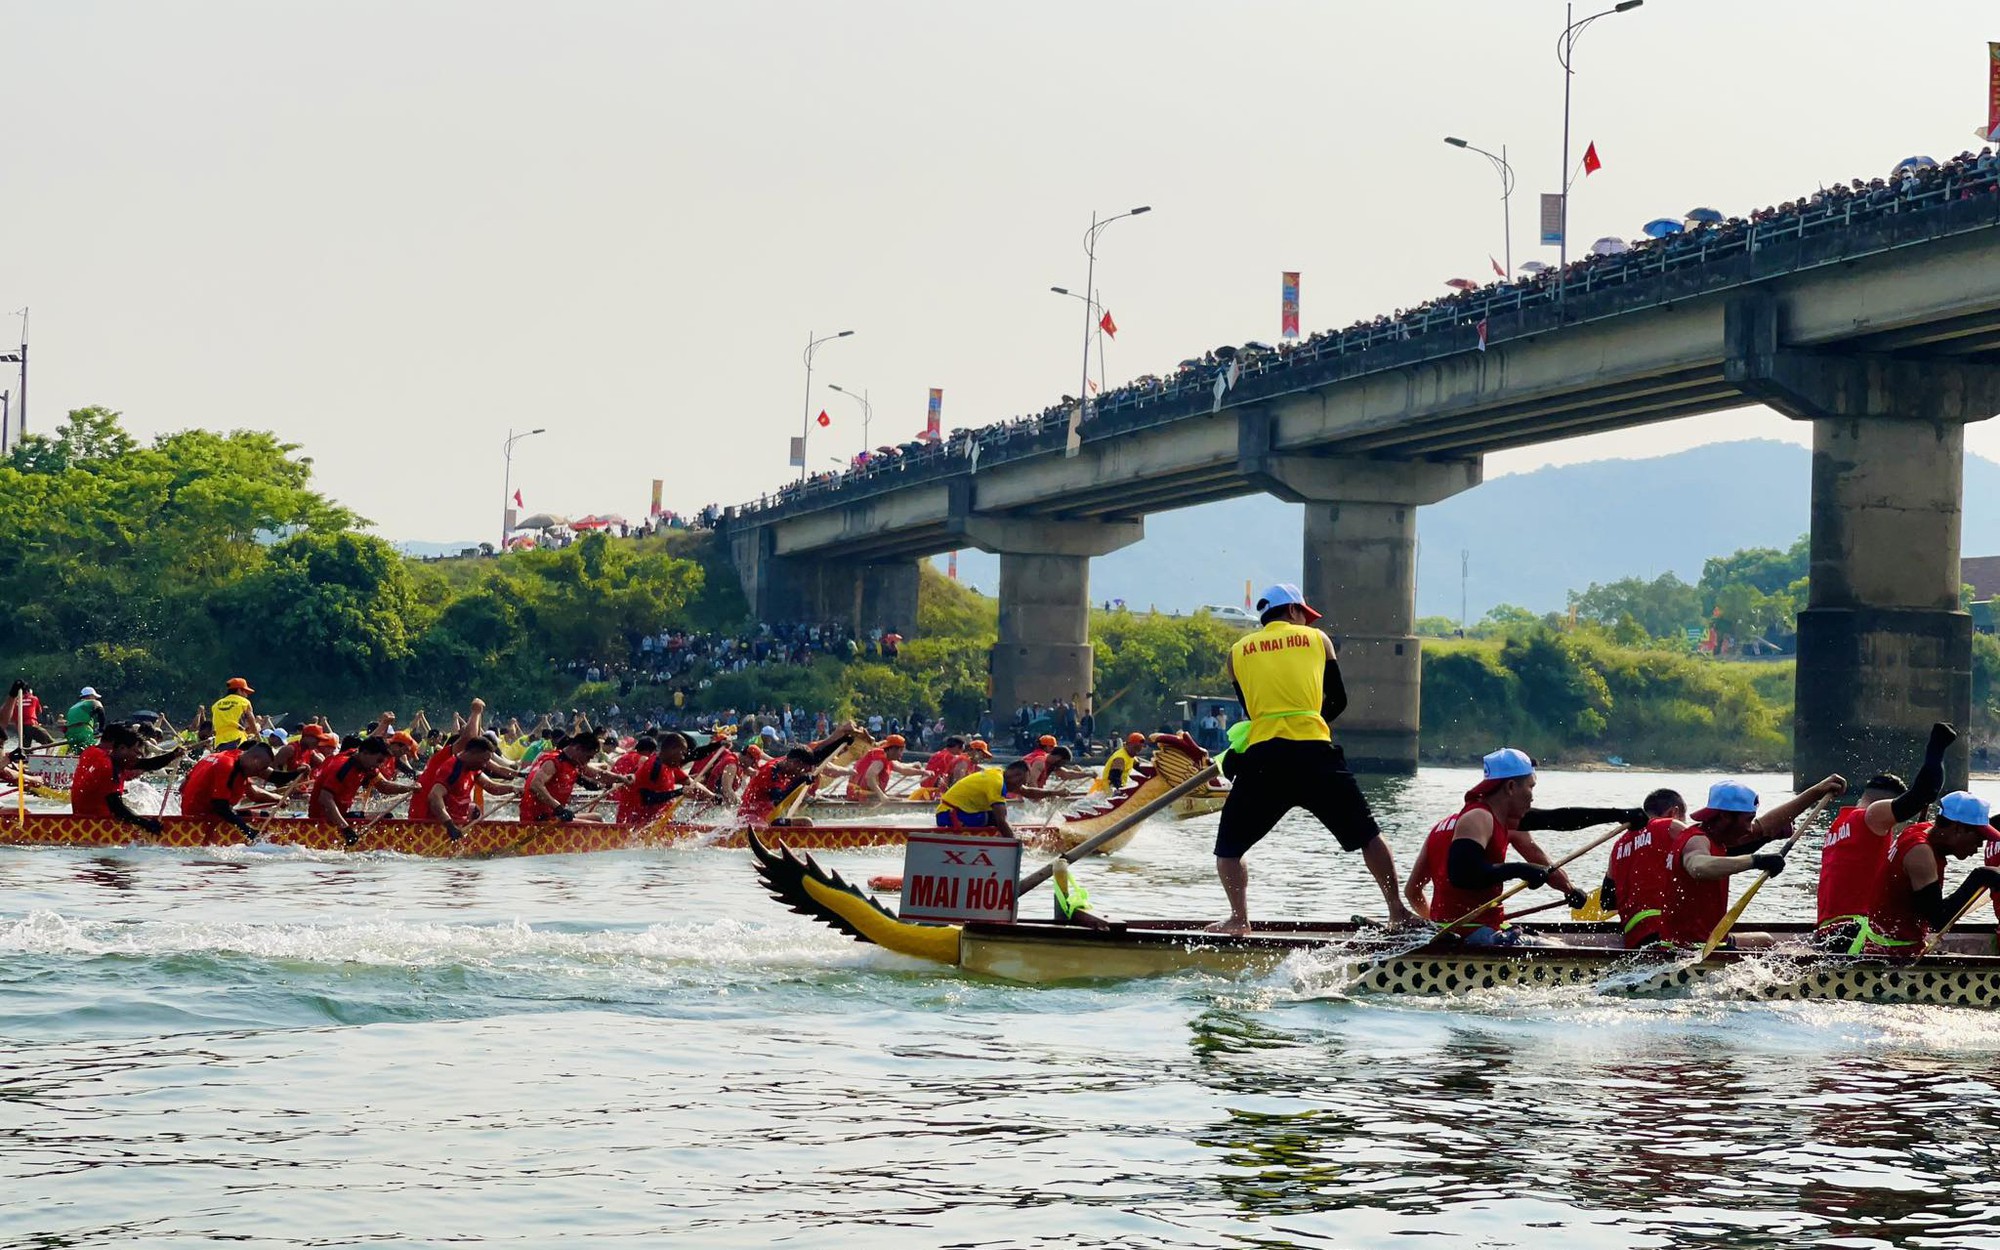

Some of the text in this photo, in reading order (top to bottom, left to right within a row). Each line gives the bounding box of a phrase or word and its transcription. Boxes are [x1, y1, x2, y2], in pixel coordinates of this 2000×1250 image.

[1259, 638, 1283, 652] MAI
[910, 872, 1014, 911] MAI HÓA
